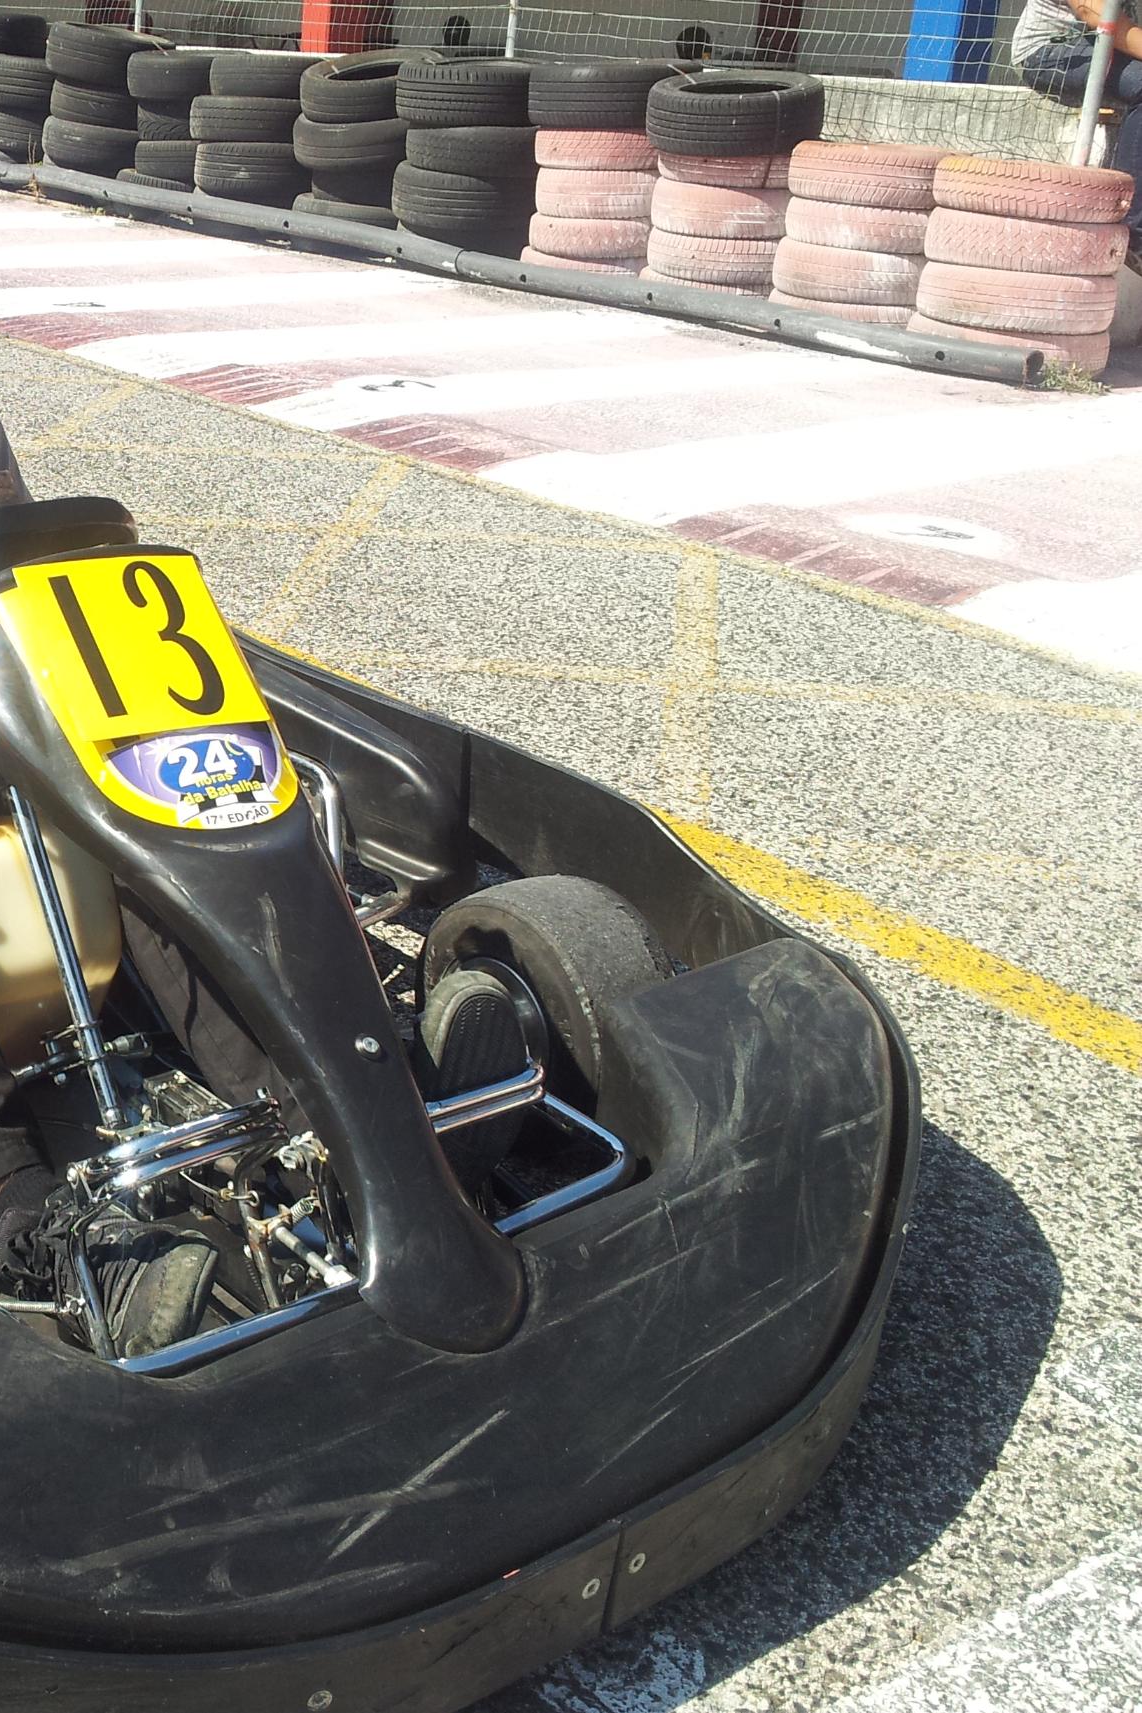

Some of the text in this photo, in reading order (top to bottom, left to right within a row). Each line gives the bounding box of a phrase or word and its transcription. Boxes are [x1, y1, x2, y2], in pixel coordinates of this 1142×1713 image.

[47, 560, 225, 718] 13
[183, 779, 263, 806] da Batalha
